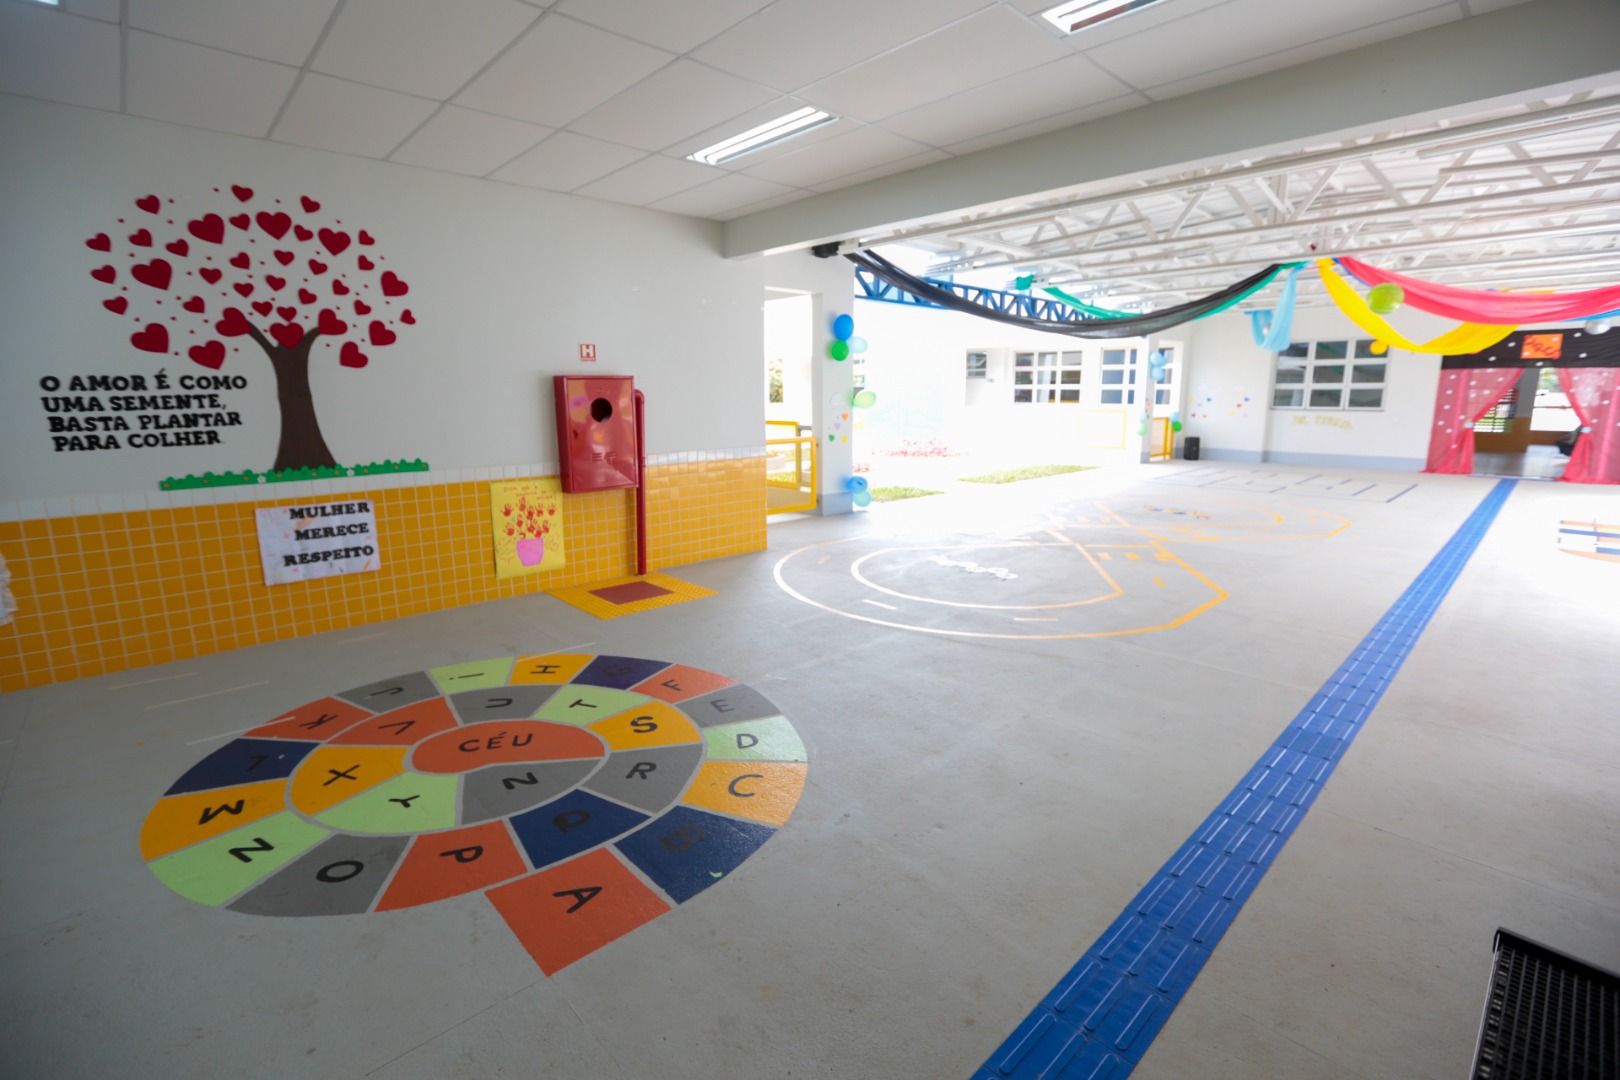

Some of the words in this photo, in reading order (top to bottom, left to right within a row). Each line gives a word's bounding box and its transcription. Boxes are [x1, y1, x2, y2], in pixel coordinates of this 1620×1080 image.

[40, 375, 61, 392] O
[69, 375, 148, 392] AMOR
[154, 368, 171, 390] É
[179, 375, 248, 390] COMO
[40, 396, 105, 413] UMA
[109, 394, 227, 412] SEMENTE,
[47, 416, 130, 433] BASTA
[137, 412, 243, 430] PLANTAR
[52, 435, 121, 452] PARA
[289, 502, 370, 520] MULHER
[294, 523, 369, 541] MERECE
[283, 545, 374, 567] RESPEITO
[530, 664, 561, 675] H
[661, 679, 682, 692] F
[568, 698, 598, 711] T
[710, 698, 735, 713] E
[298, 714, 338, 731] K
[630, 716, 658, 733] S
[458, 731, 533, 752] CÉU
[736, 733, 760, 749] D
[322, 764, 360, 786] X
[625, 761, 657, 780] R
[728, 774, 764, 797] C
[388, 794, 421, 808] Y
[658, 823, 706, 852] B
[439, 845, 483, 863] P
[316, 860, 365, 883] O
[553, 886, 603, 914] A
